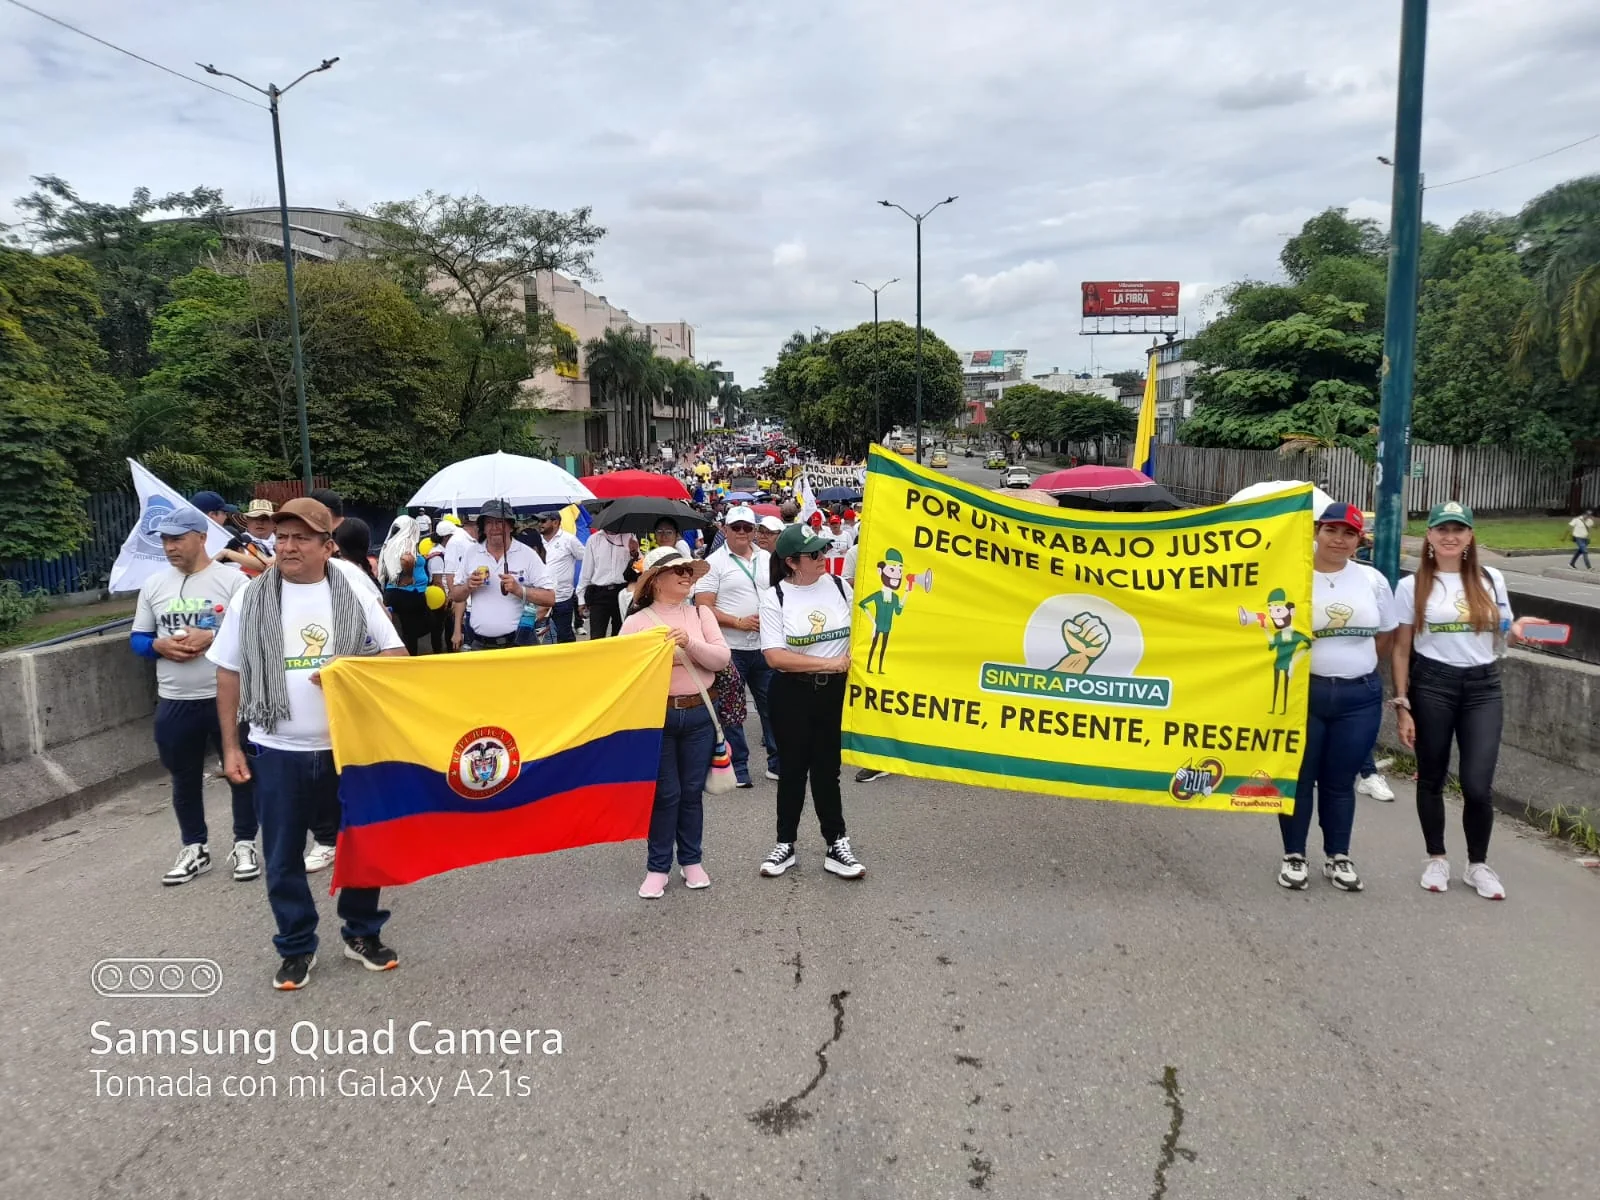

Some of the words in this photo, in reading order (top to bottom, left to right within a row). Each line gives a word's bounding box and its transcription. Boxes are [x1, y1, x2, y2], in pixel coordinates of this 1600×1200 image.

[1113, 293, 1124, 305] LA
[1125, 293, 1149, 305] FIBRA
[906, 488, 961, 522] POR
[971, 509, 1009, 534] UN
[1017, 525, 1154, 558] TRABAJO
[1166, 527, 1272, 558] JUSTO,
[914, 525, 1039, 570] DECENTE
[1050, 557, 1064, 576] E
[1075, 562, 1259, 591] INCLUYENTE
[165, 598, 206, 613] JUST
[787, 628, 851, 645] SINTRAPOSITIVA
[984, 668, 1165, 701] SINTRAPOSITIVA
[849, 684, 988, 730] PRESENTE,
[1000, 705, 1150, 747] PRESENTE,
[1163, 721, 1300, 754] PRESENTE
[1184, 769, 1212, 793] CUT
